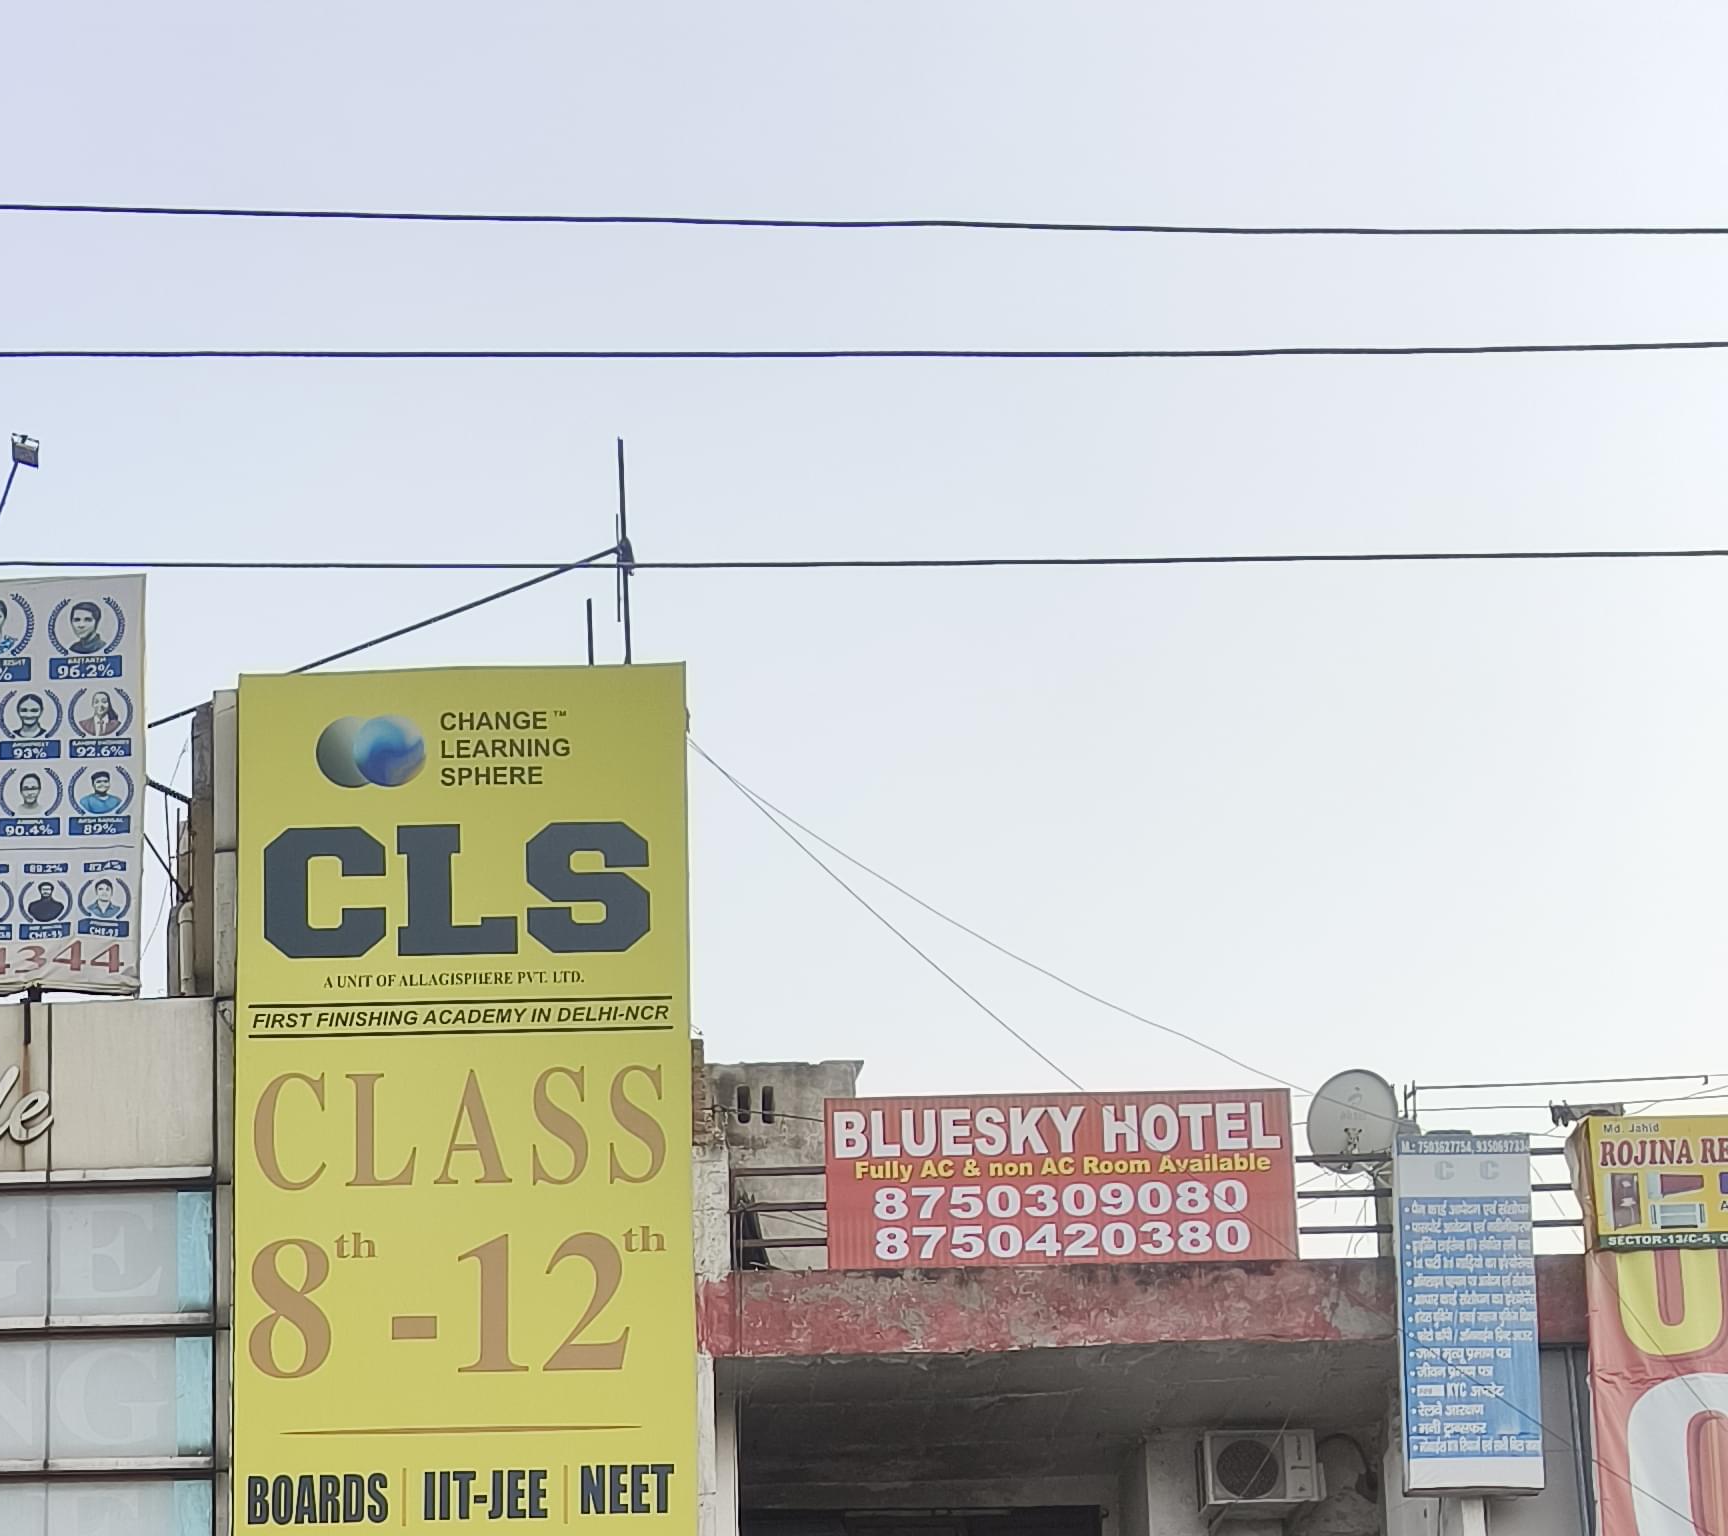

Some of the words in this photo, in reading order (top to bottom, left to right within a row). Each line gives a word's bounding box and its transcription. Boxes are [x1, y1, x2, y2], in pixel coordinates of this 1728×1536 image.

[57, 664, 114, 679] 96.2%
[440, 711, 548, 731] CHANGE
[440, 738, 571, 758] LEARNING
[440, 767, 544, 786] SPHERE
[264, 821, 650, 959] CLS
[399, 972, 514, 987] ALLAGISPHERE
[252, 1012, 312, 1030] FIRST
[316, 1009, 419, 1028] FINISHING
[423, 1007, 528, 1026] ACADEMY
[559, 1004, 670, 1023] DELHI-NCR
[253, 1064, 667, 1191] CLASS
[833, 1106, 1084, 1159] BLUESKY
[1101, 1102, 1281, 1153] HOTEL
[1627, 1121, 1660, 1135] Jahid
[1600, 1138, 1695, 1166] ROJINA
[855, 1160, 914, 1181] Fully
[920, 1159, 955, 1178] AC
[989, 1160, 1034, 1177] non
[1041, 1157, 1075, 1176] AC
[1084, 1155, 1151, 1175] Room
[1158, 1153, 1271, 1173] Available
[873, 1180, 1248, 1221] 8750309080
[874, 1219, 1251, 1261] 8750420380
[247, 1472, 389, 1525] BOARDS
[423, 1469, 548, 1521] IIT-JEE
[580, 1464, 675, 1515] NEET
